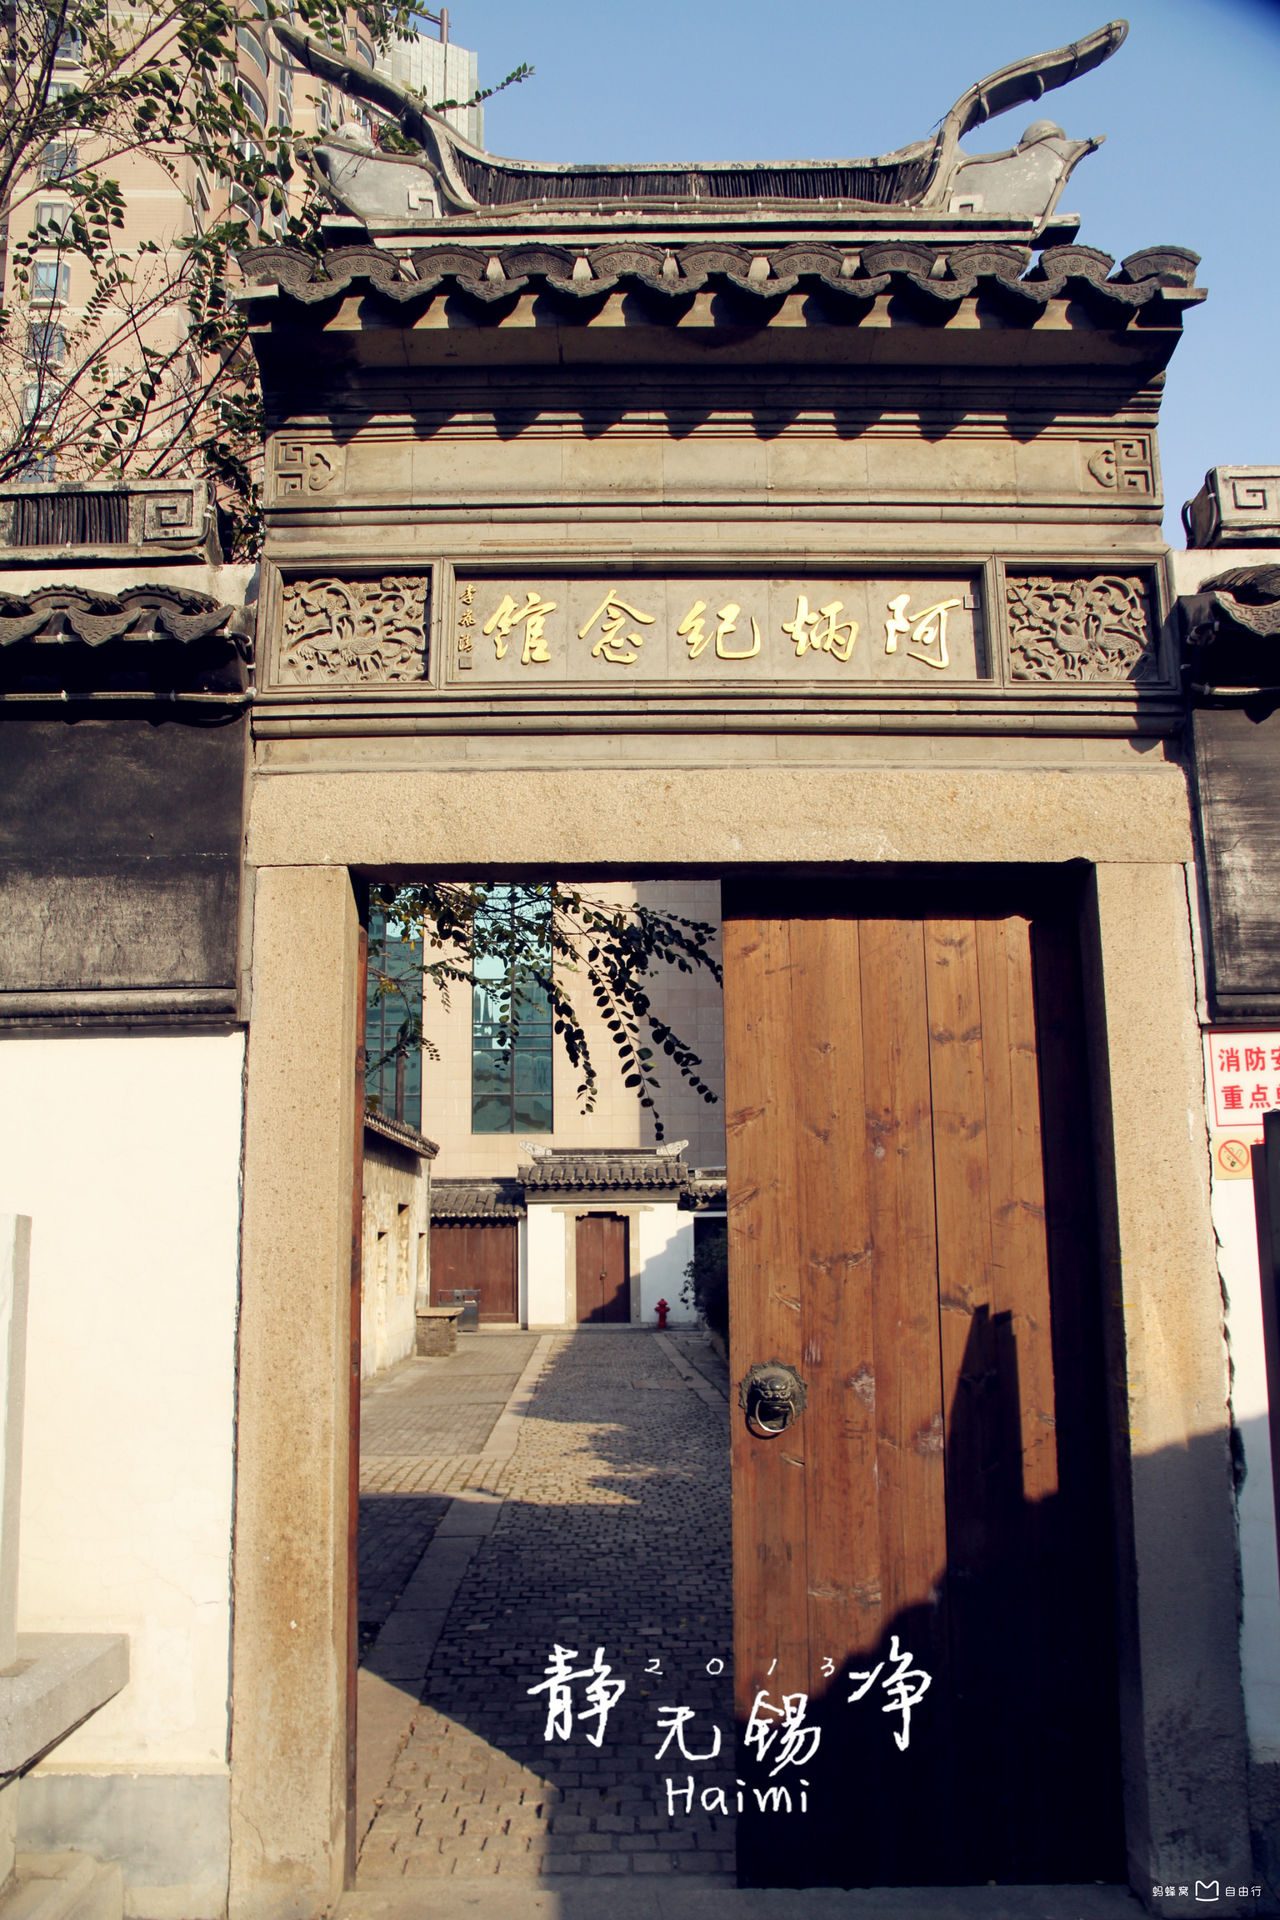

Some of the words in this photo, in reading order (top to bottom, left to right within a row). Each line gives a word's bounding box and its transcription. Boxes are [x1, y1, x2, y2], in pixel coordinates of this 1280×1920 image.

[483, 589, 961, 668] 阿炳纪念馆
[1221, 1084, 1280, 1110] 重点
